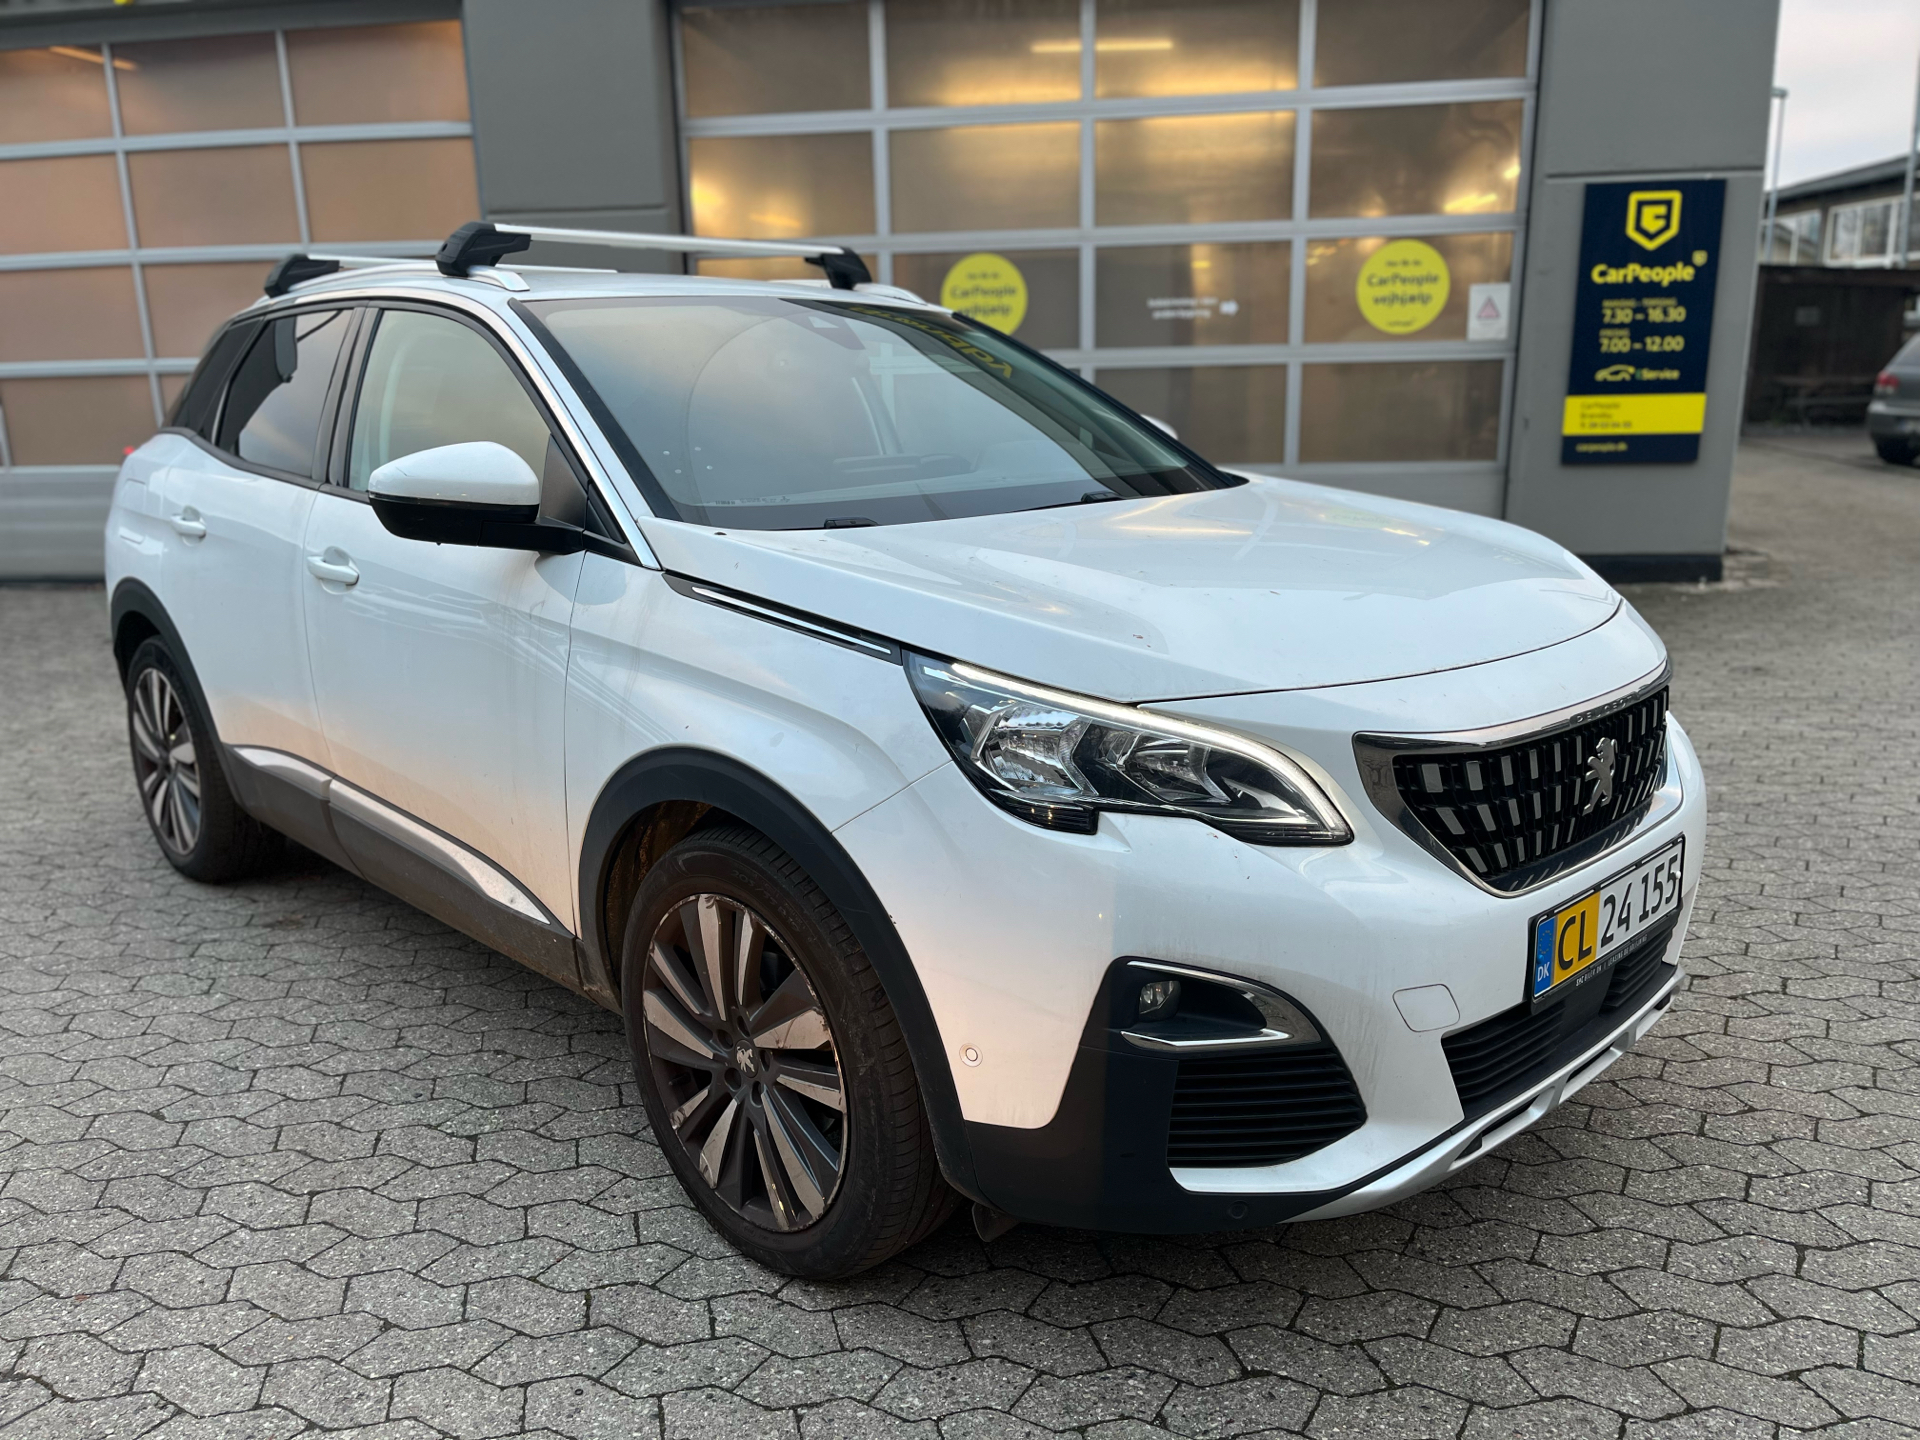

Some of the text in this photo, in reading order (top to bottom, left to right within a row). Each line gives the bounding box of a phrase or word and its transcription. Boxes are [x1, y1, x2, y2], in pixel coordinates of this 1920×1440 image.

[1366, 271, 1440, 288] CarPeople
[1591, 261, 1695, 287] CarPeople
[1601, 308, 1633, 324] 7.30
[1645, 335, 1684, 352] 12.00
[1558, 853, 1679, 970] CL 24 155
[1537, 962, 1550, 983] DK
